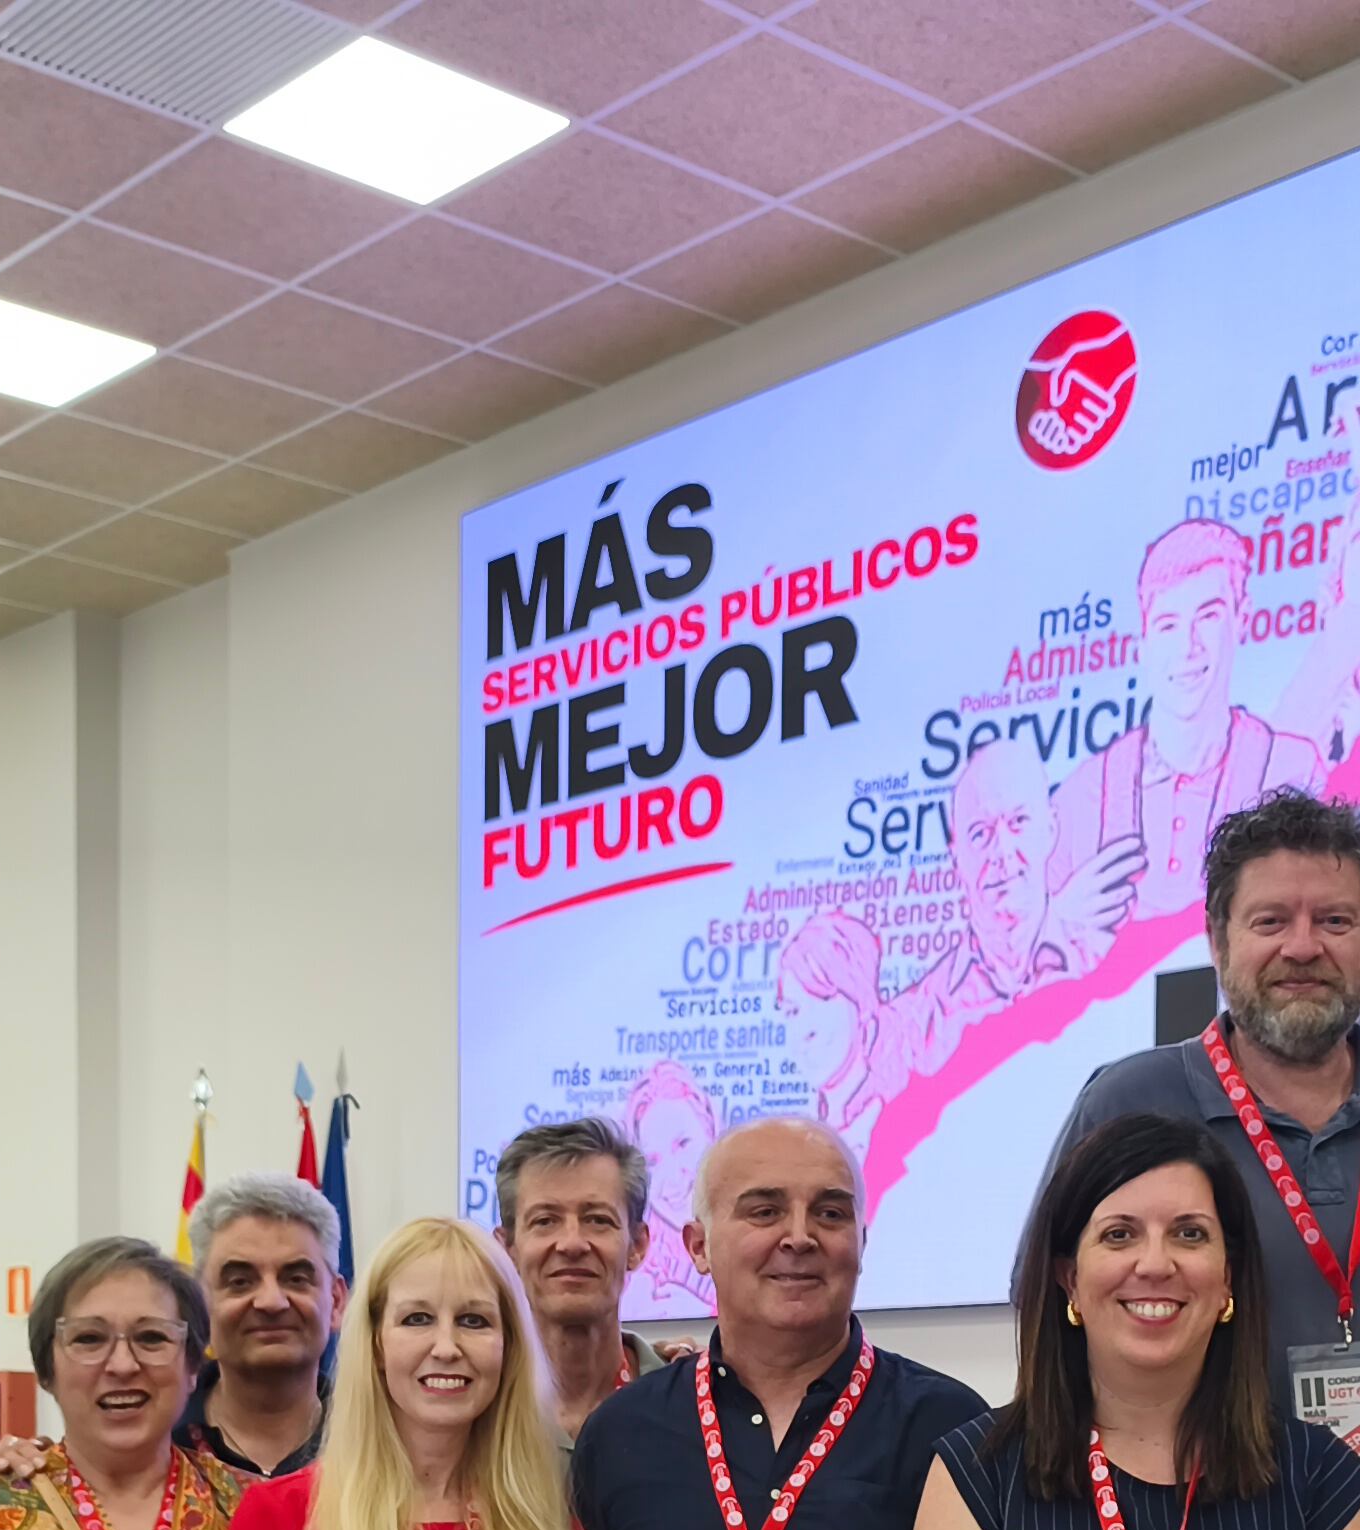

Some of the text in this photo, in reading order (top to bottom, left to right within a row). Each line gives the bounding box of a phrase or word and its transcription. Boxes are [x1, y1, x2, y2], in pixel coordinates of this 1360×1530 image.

[1191, 443, 1264, 482] mejor
[1243, 513, 1344, 575] ñar
[486, 478, 714, 662] MÁS
[482, 512, 980, 713] SERVICIOS PÚBLICOS
[1040, 591, 1112, 638] más
[1016, 678, 1060, 706] Local
[484, 614, 859, 823] MEJOR
[853, 772, 909, 797] Sanidad
[482, 773, 724, 888] FUTURO
[743, 868, 898, 915] Administración
[708, 912, 789, 947] Estado
[681, 936, 781, 985] Corr
[666, 996, 762, 1019] Servicios
[615, 1017, 787, 1058] Transporte sanita
[552, 1061, 591, 1087] más
[714, 1058, 771, 1078] General
[780, 1059, 802, 1075] de
[762, 1077, 816, 1095] Bienes
[1304, 1408, 1327, 1417] MÁS
[1327, 1387, 1355, 1399] UGT
